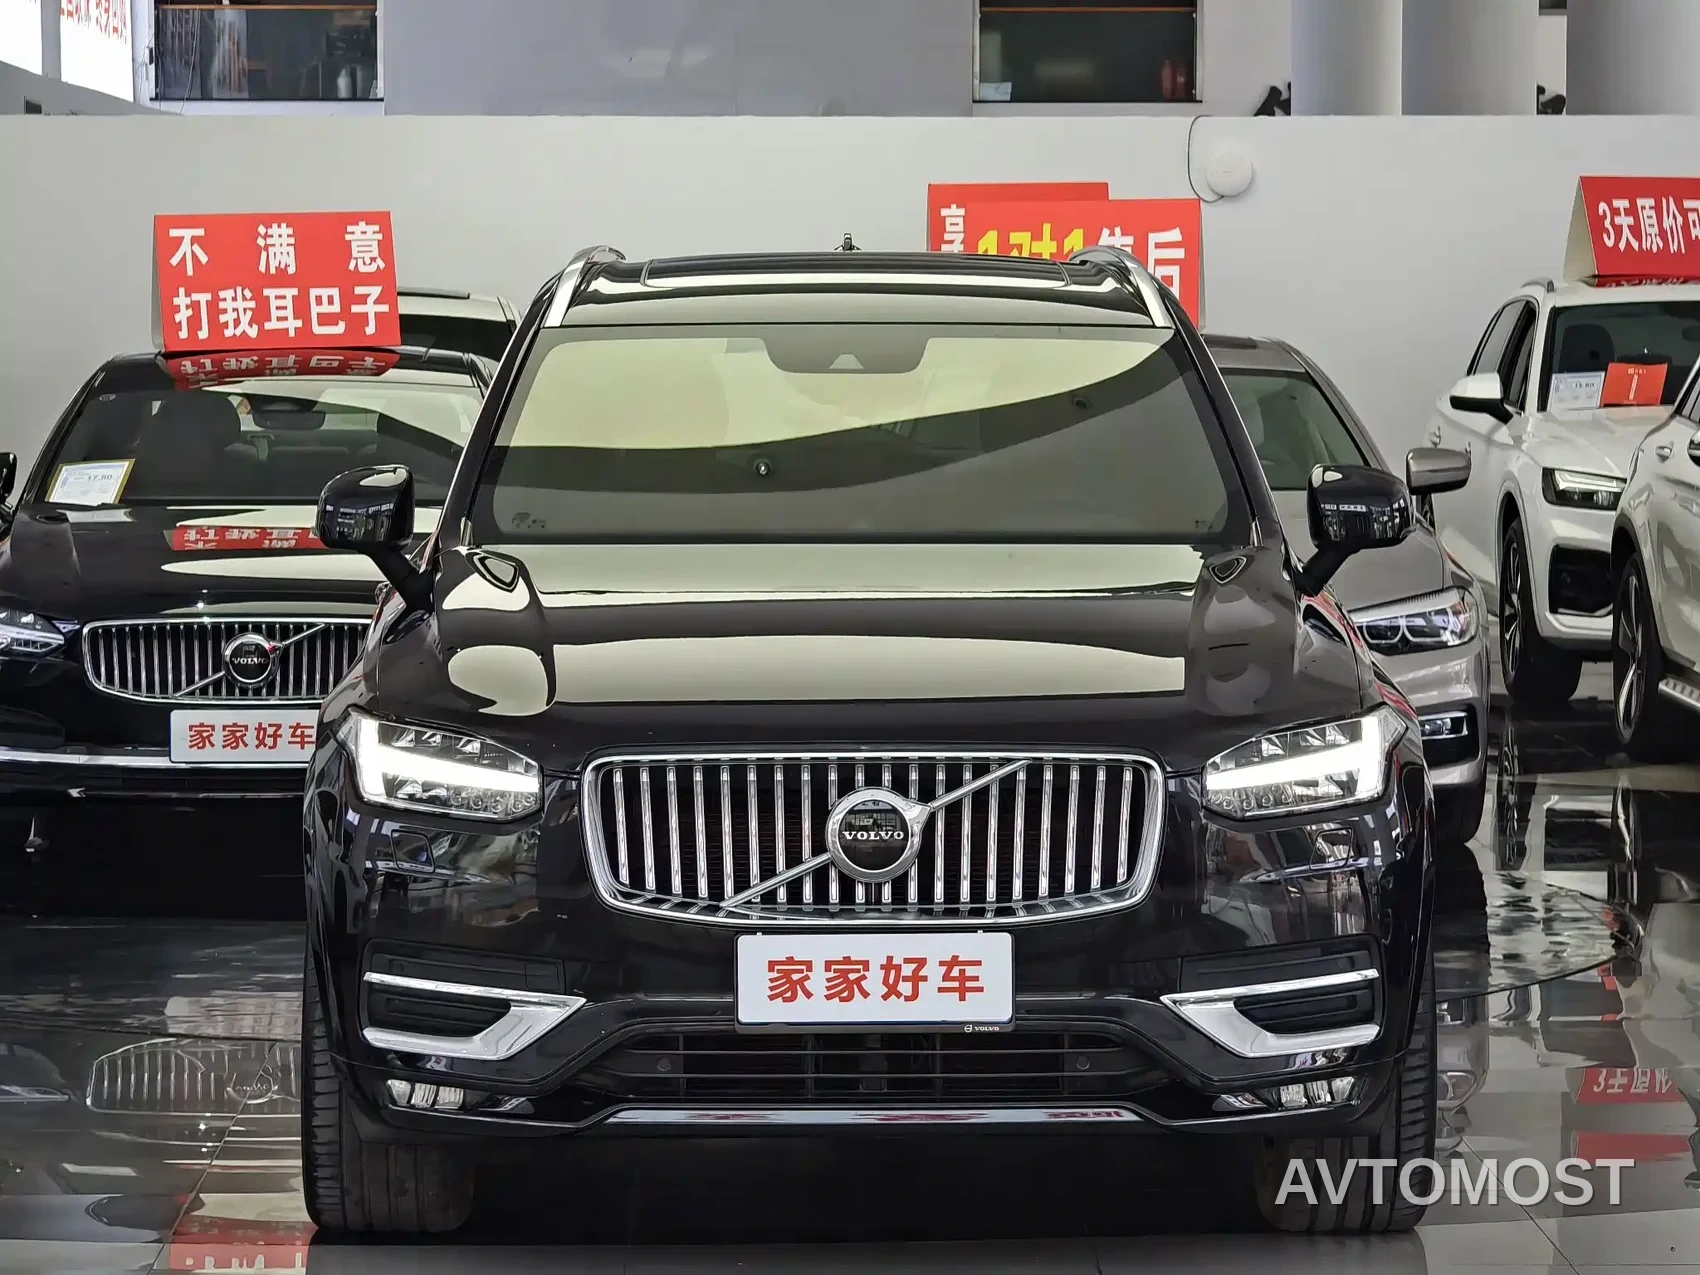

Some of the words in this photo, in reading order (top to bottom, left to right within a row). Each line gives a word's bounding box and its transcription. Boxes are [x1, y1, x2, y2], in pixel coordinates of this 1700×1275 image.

[168, 220, 386, 277] 不满意
[173, 285, 390, 340] 打我耳巴子
[188, 722, 316, 750] 家家好车
[842, 831, 904, 840] VOLVO
[767, 955, 984, 1003] 家家好车
